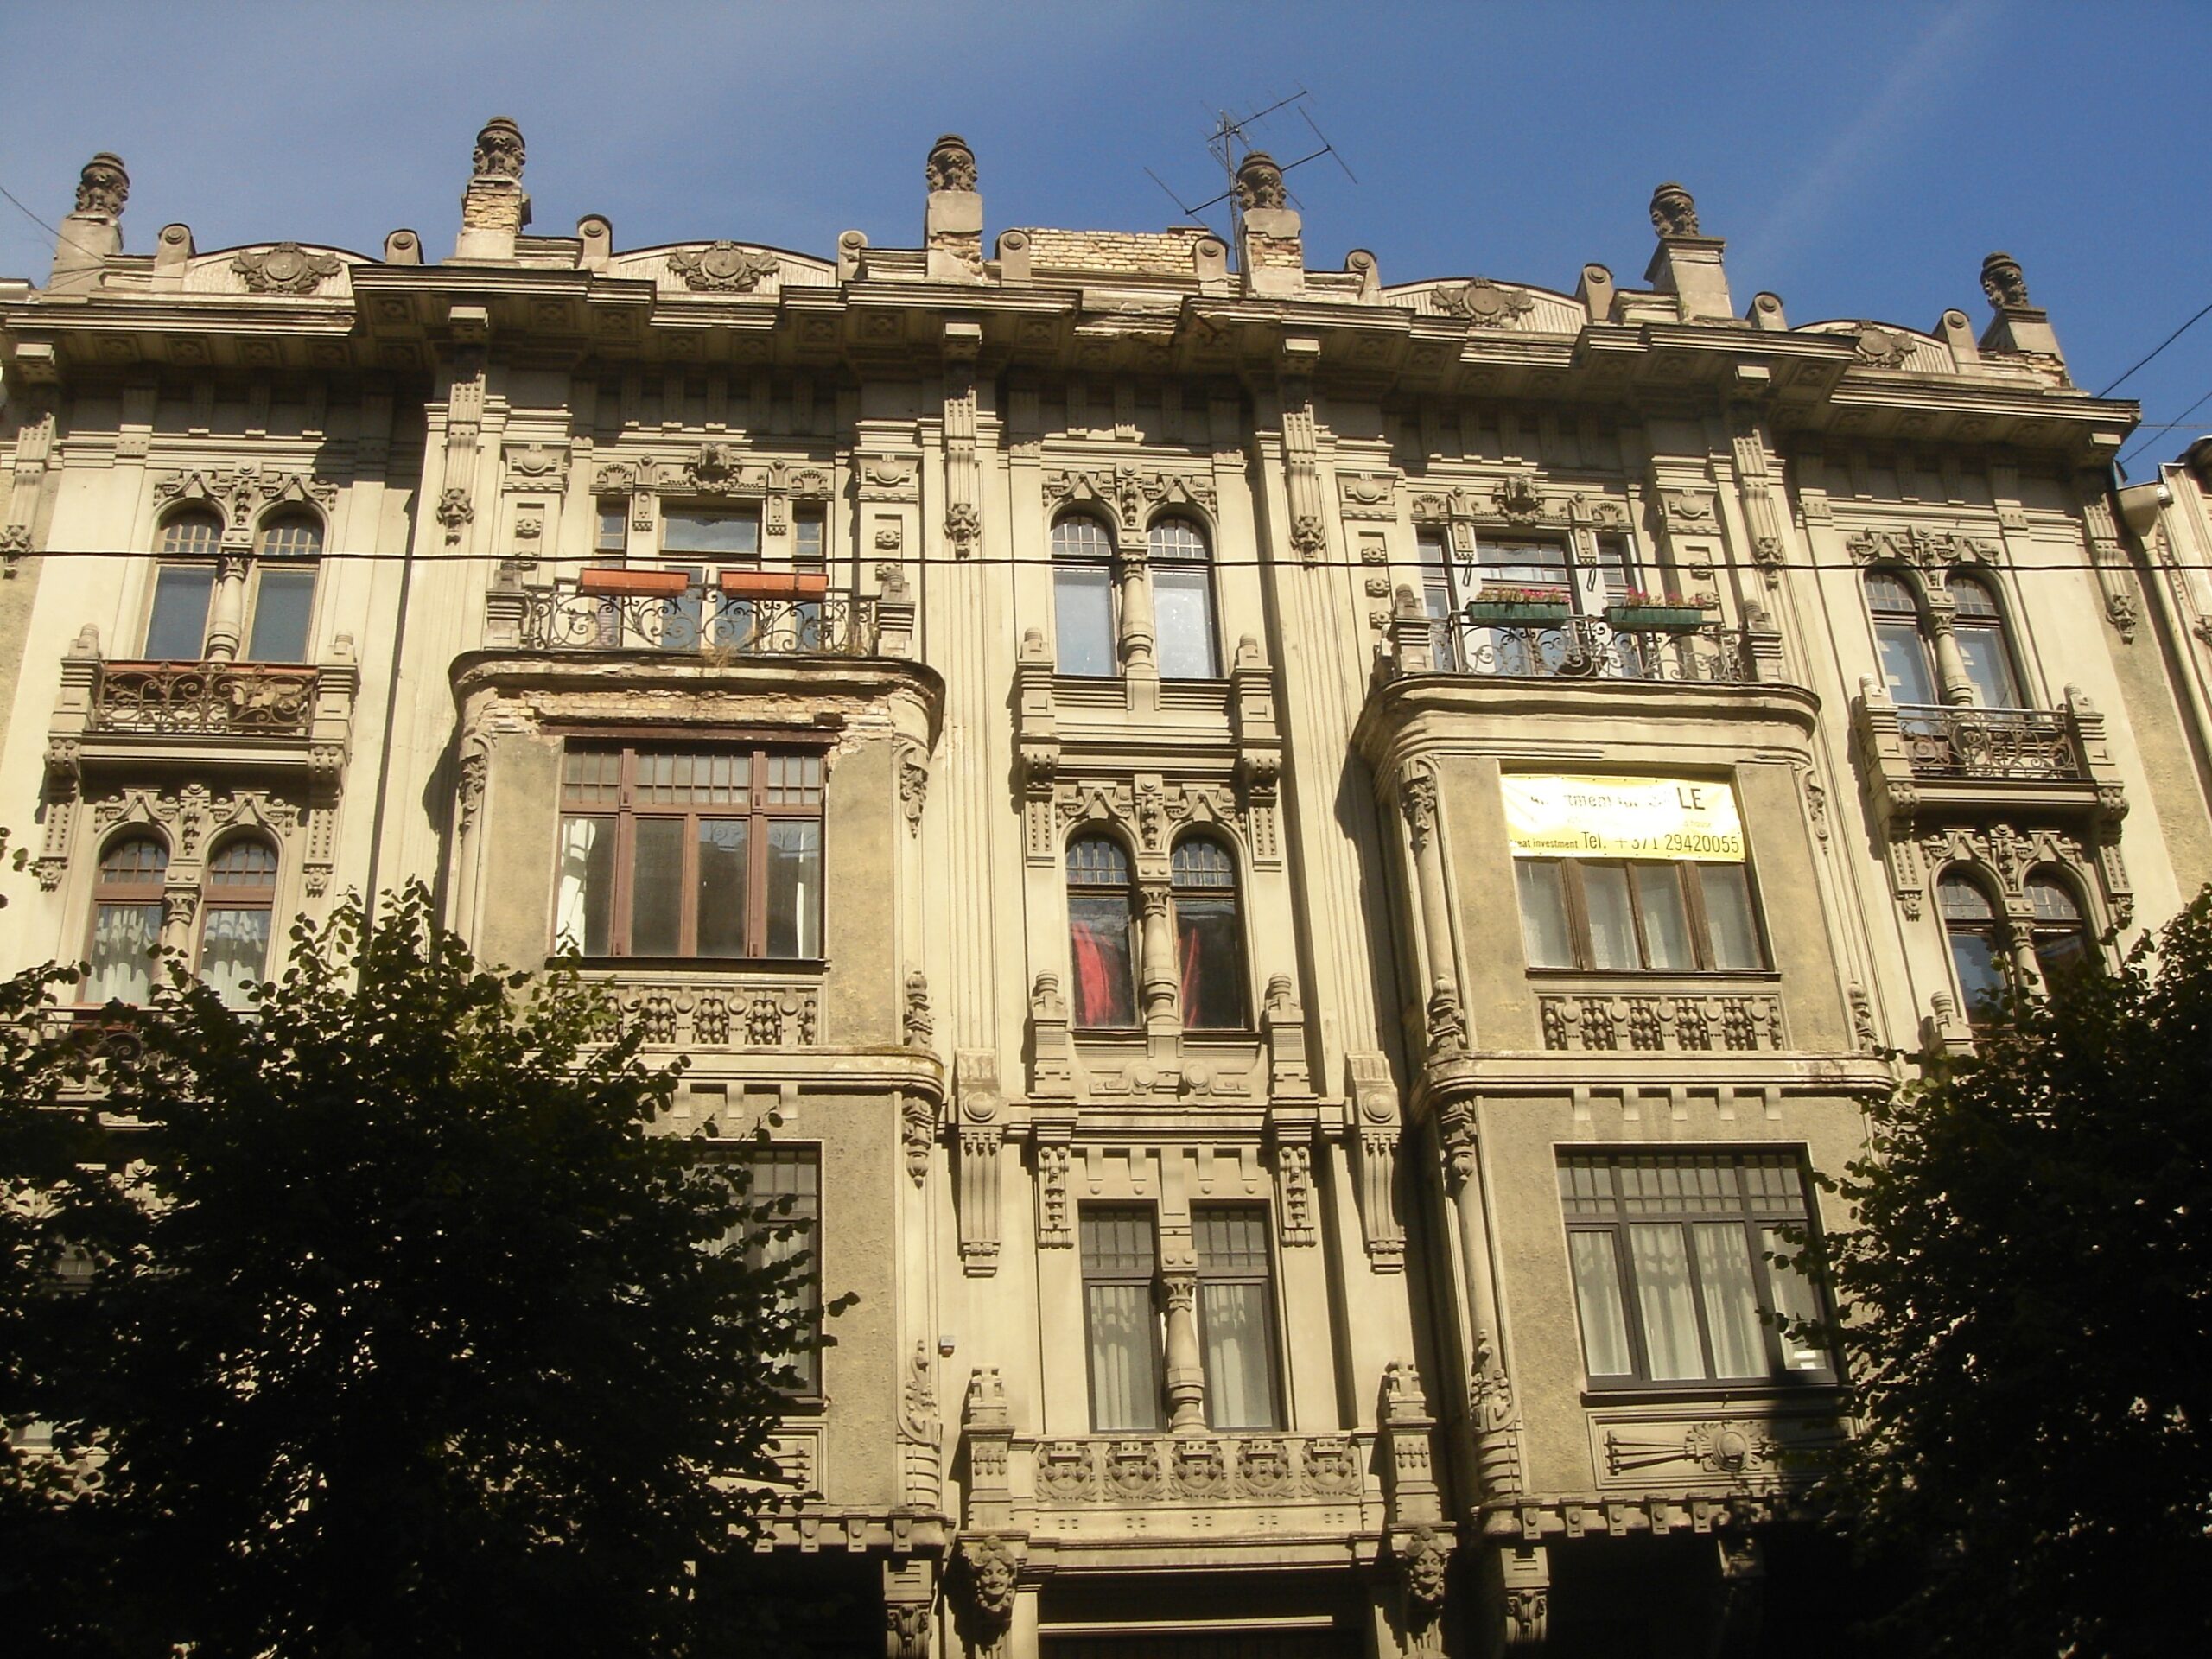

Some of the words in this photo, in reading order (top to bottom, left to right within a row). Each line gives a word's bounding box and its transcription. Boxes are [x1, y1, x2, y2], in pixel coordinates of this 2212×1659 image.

[1509, 839, 1530, 849] eat
[1532, 838, 1579, 849] investment
[1580, 831, 1607, 849] Tel.
[1664, 833, 1739, 854] 29420055
